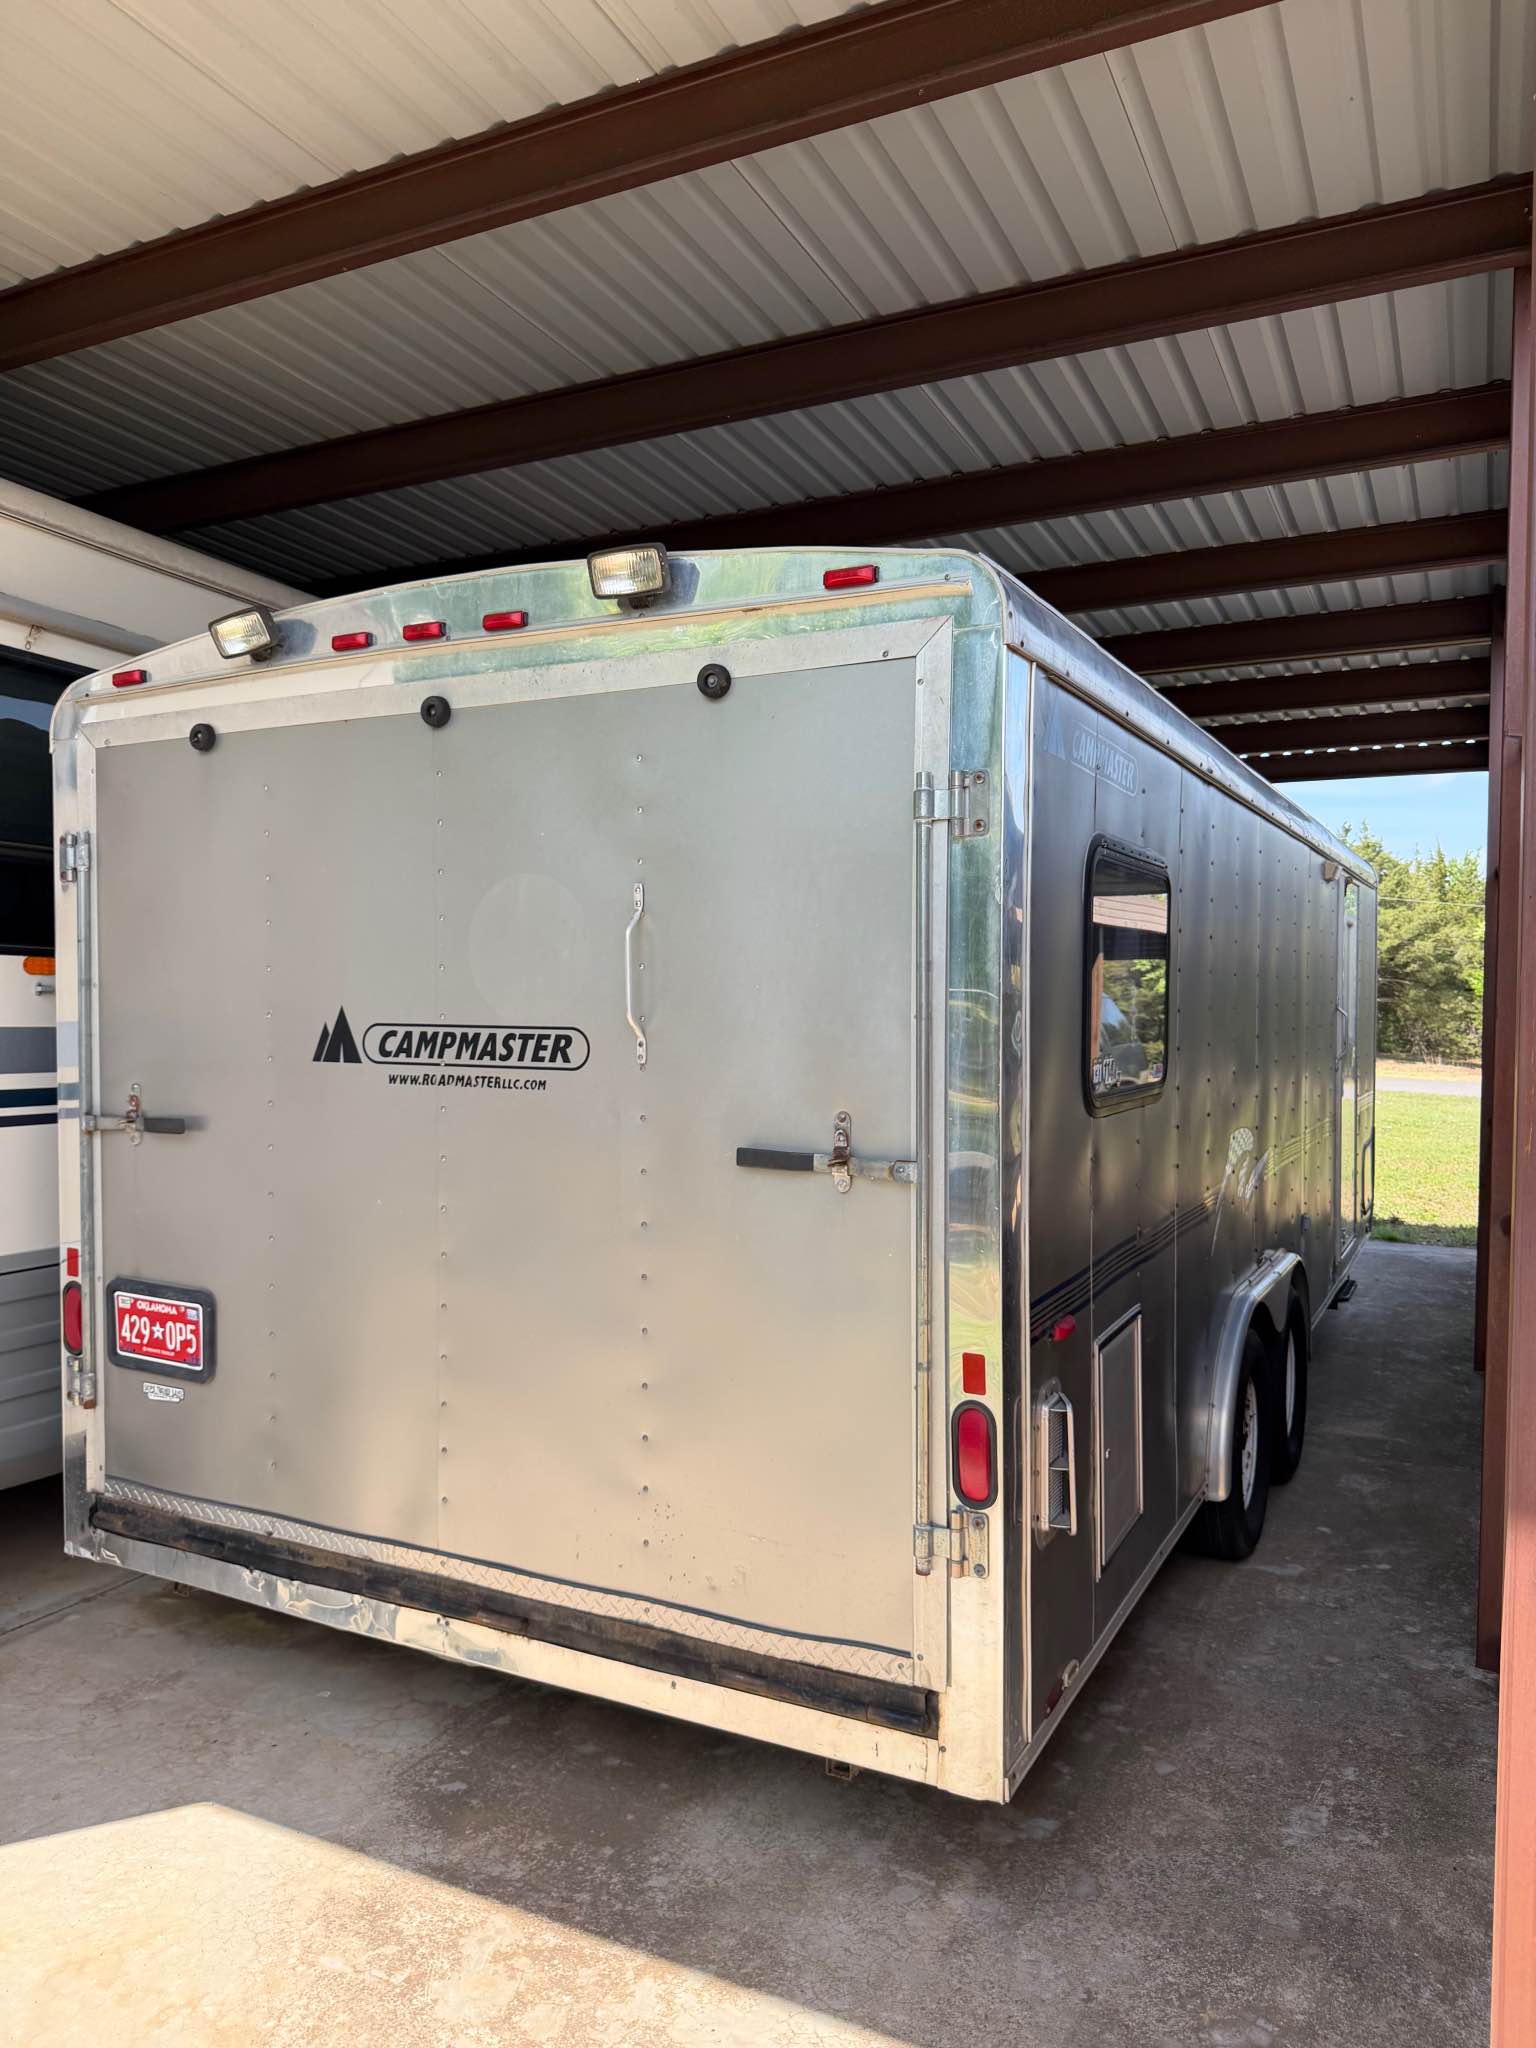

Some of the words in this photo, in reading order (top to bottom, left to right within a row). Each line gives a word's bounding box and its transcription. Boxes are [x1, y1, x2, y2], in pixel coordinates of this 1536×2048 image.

[378, 1029, 574, 1064] CAMPMASTER
[388, 1073, 547, 1091] WWW.ROADMASTERLLC.COM
[136, 1300, 178, 1315] OKLAHOMA
[121, 1313, 150, 1345] 429
